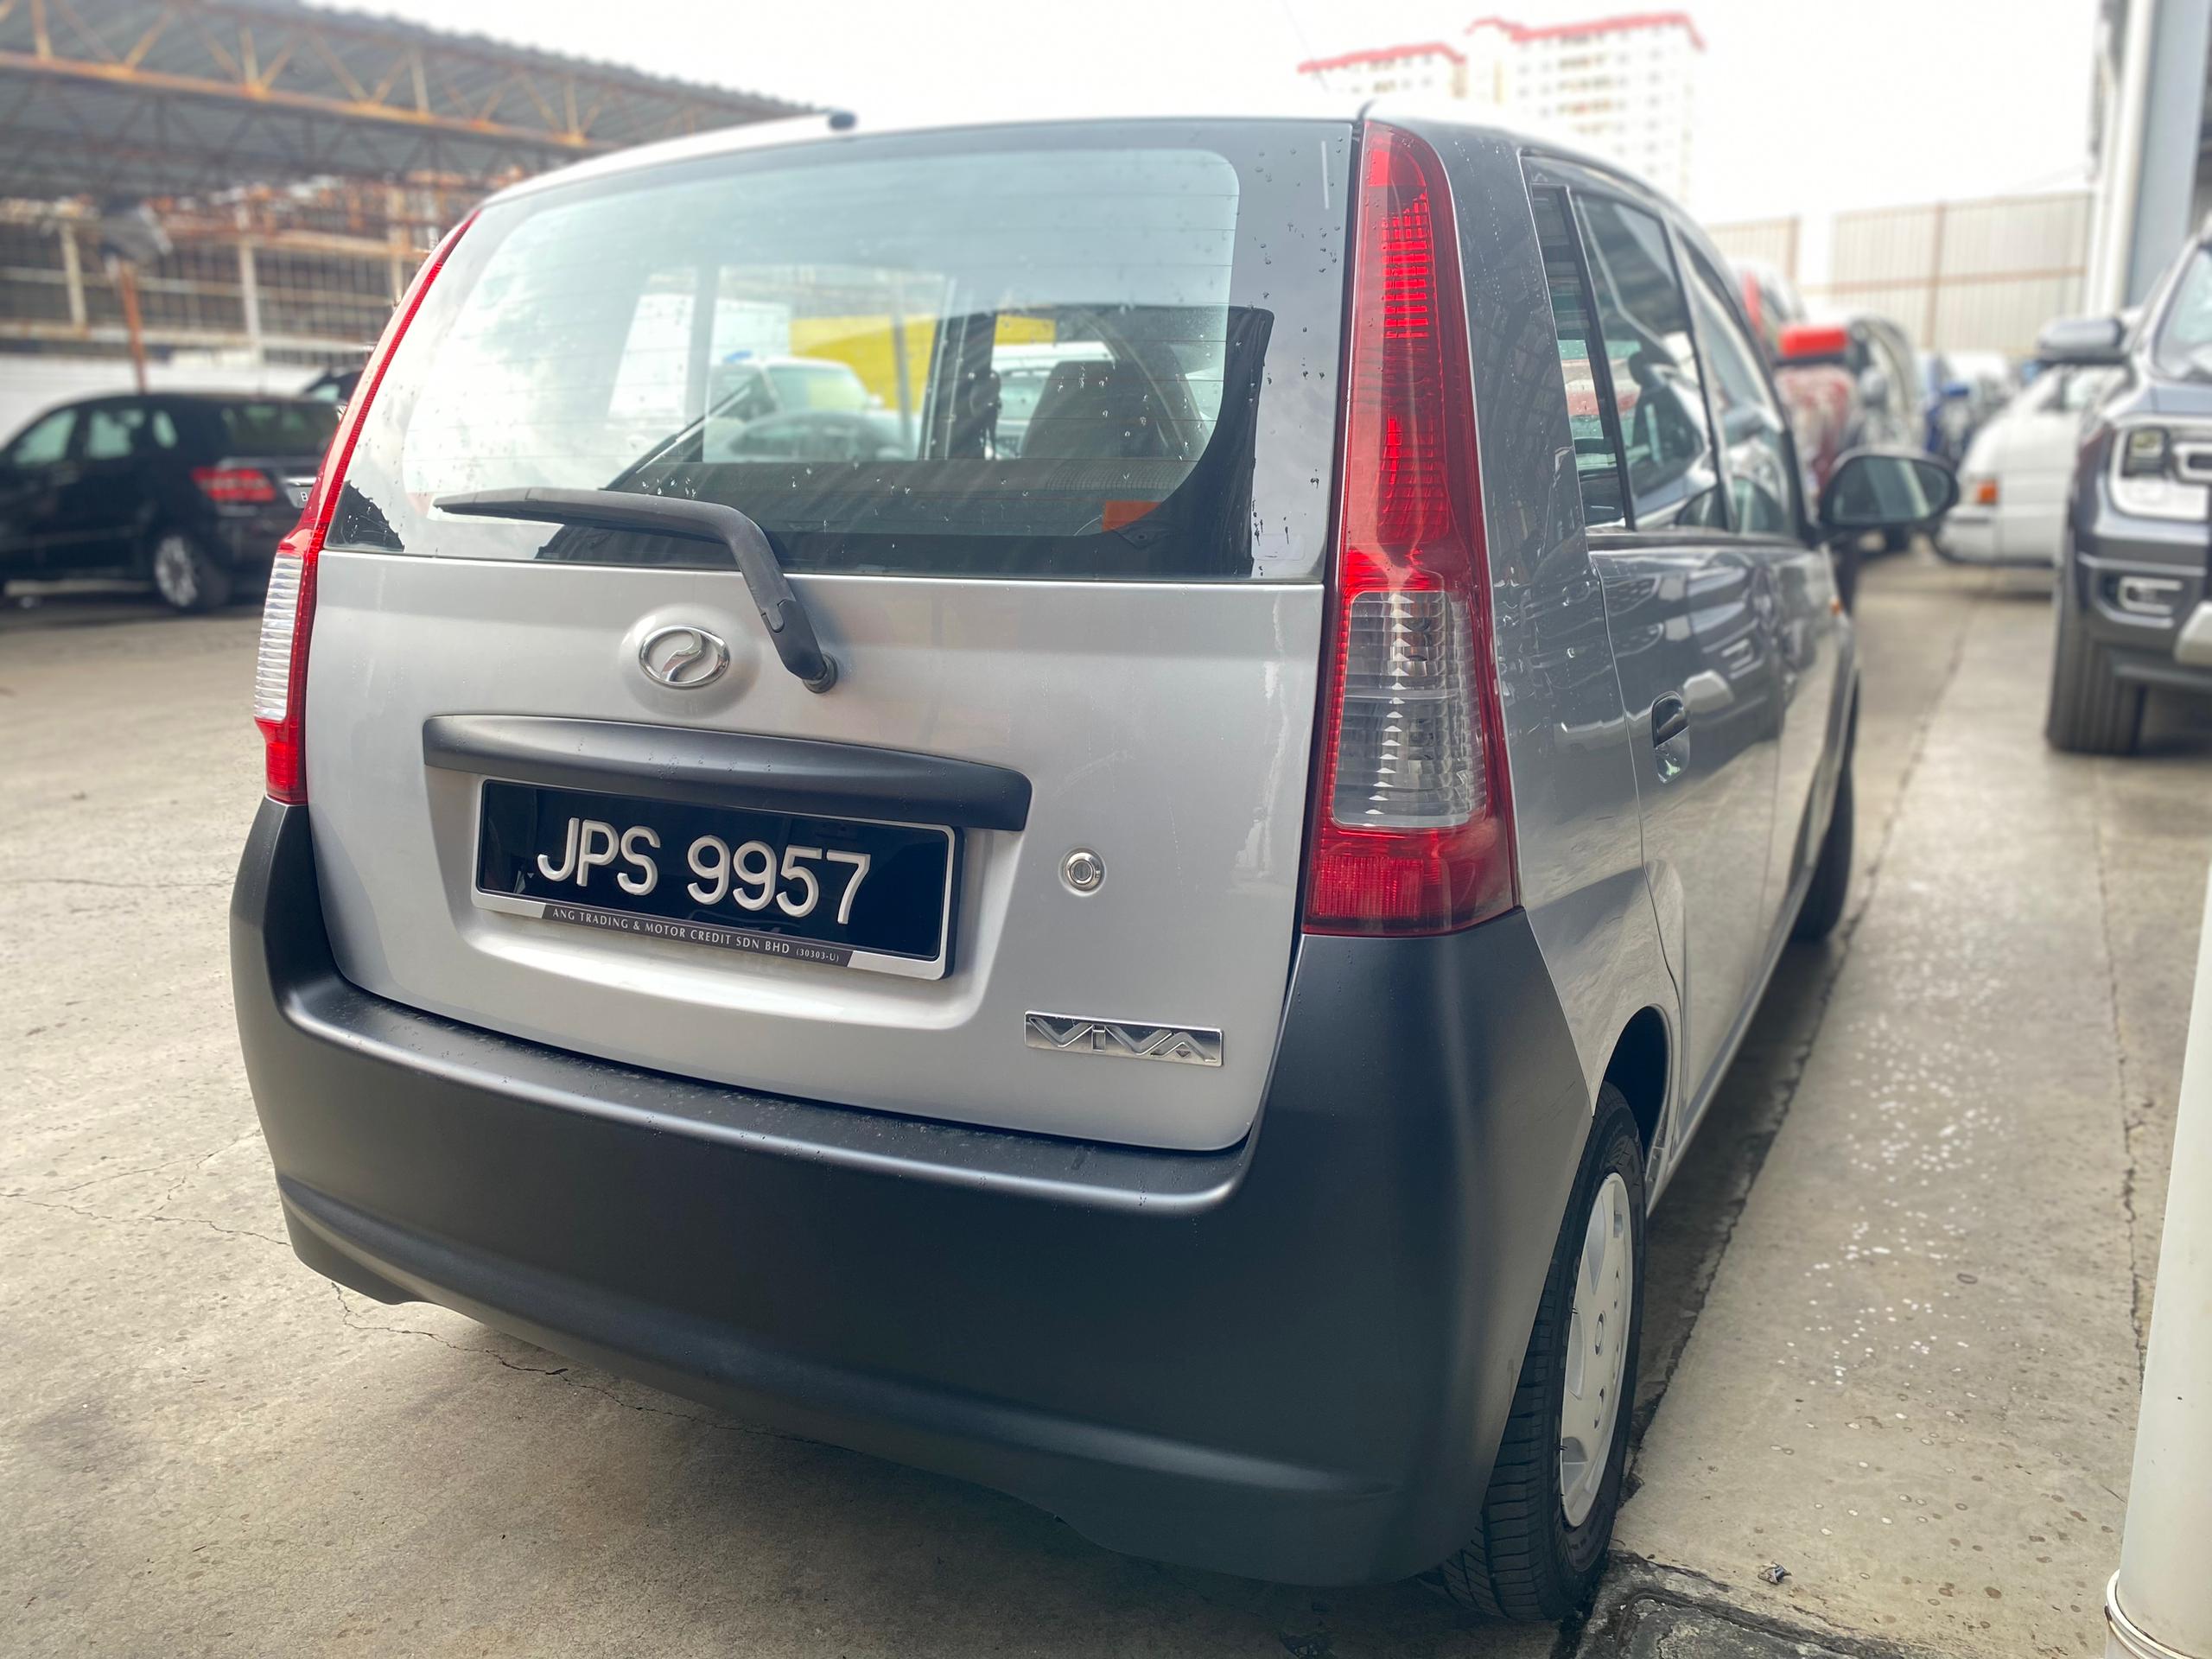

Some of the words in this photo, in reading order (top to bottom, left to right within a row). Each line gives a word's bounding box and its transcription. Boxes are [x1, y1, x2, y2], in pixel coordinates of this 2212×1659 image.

[537, 817, 661, 896] JPS
[687, 835, 871, 925] 9957
[552, 908, 575, 920] ANG
[580, 912, 629, 929] TRADING
[632, 921, 640, 931] &
[645, 923, 685, 938] MOTOR
[690, 930, 731, 944] CREDIT
[735, 936, 760, 949] SDN
[765, 941, 790, 953] BHD
[796, 948, 840, 962] (30303-U)
[1028, 1017, 1217, 1062] VIVA
